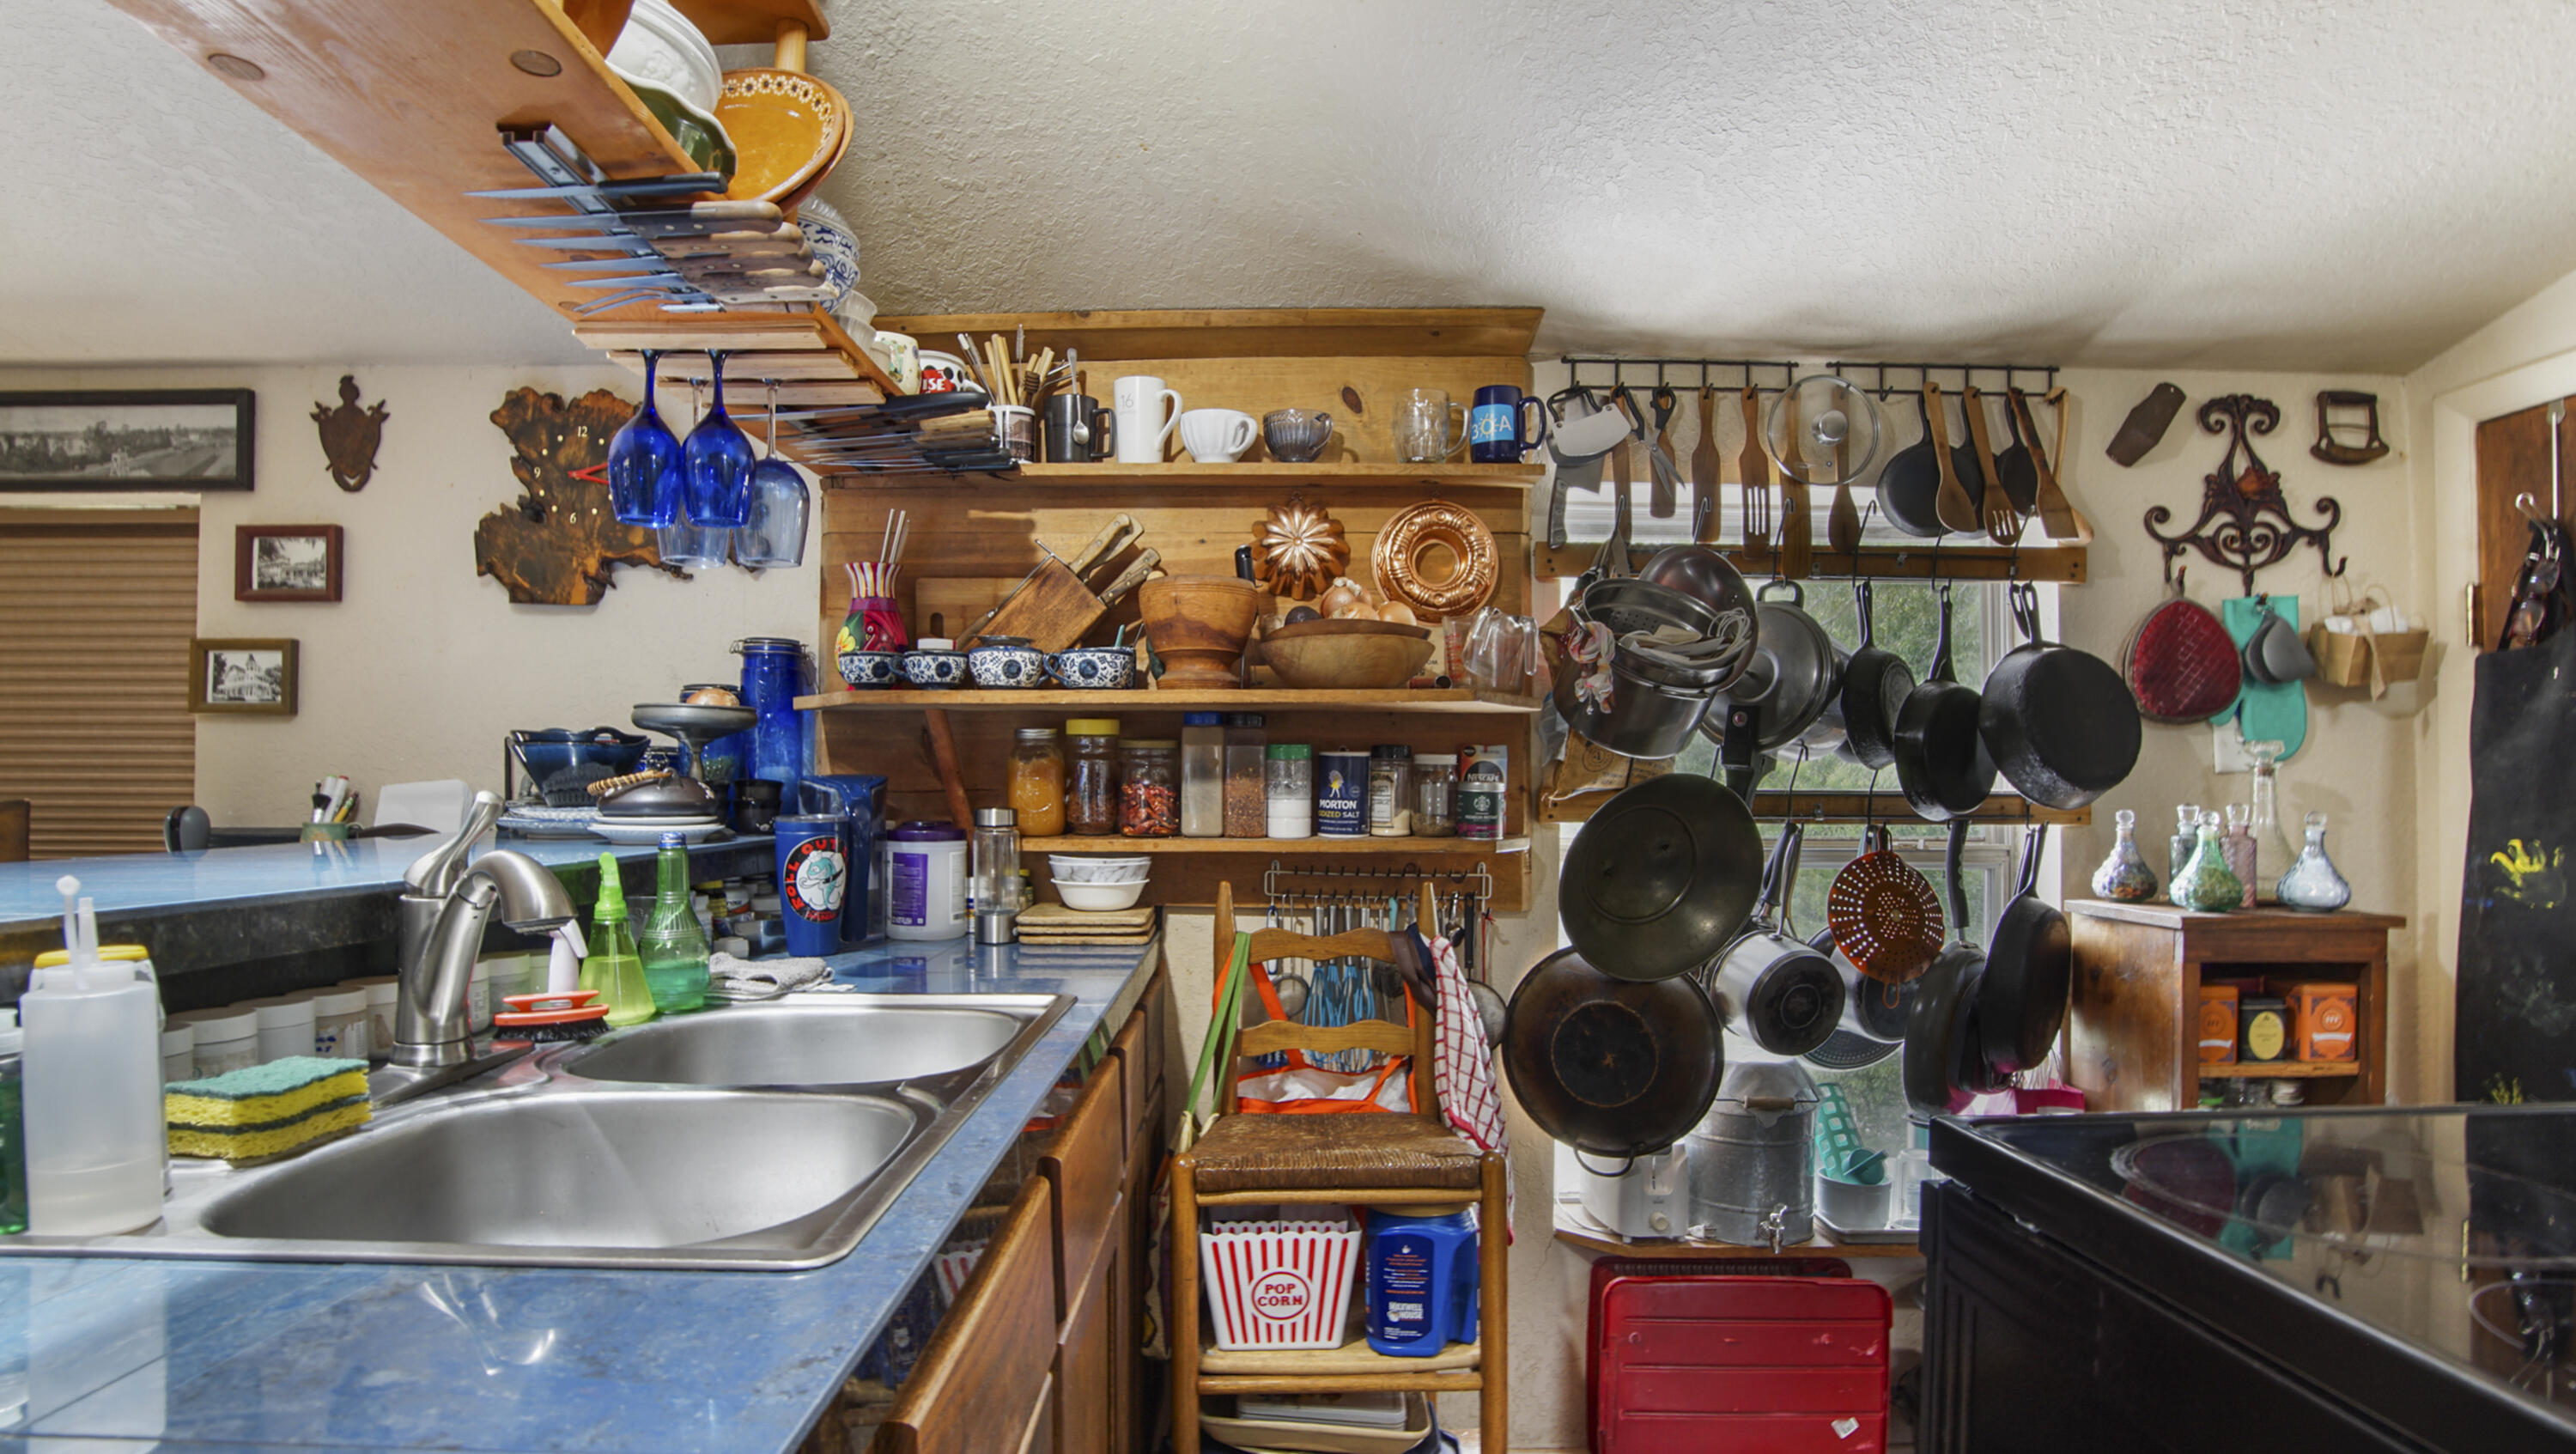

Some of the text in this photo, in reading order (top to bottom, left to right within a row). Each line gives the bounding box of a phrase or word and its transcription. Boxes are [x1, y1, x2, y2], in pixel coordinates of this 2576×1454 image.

[1121, 392, 1134, 410] 16
[577, 425, 588, 438] 12
[533, 466, 541, 479] 9
[569, 512, 577, 524] 6
[1319, 799, 1357, 810] MORTON
[786, 861, 805, 910] ROLL
[1265, 1283, 1296, 1294] POP
[1257, 1295, 1303, 1306] CORN
